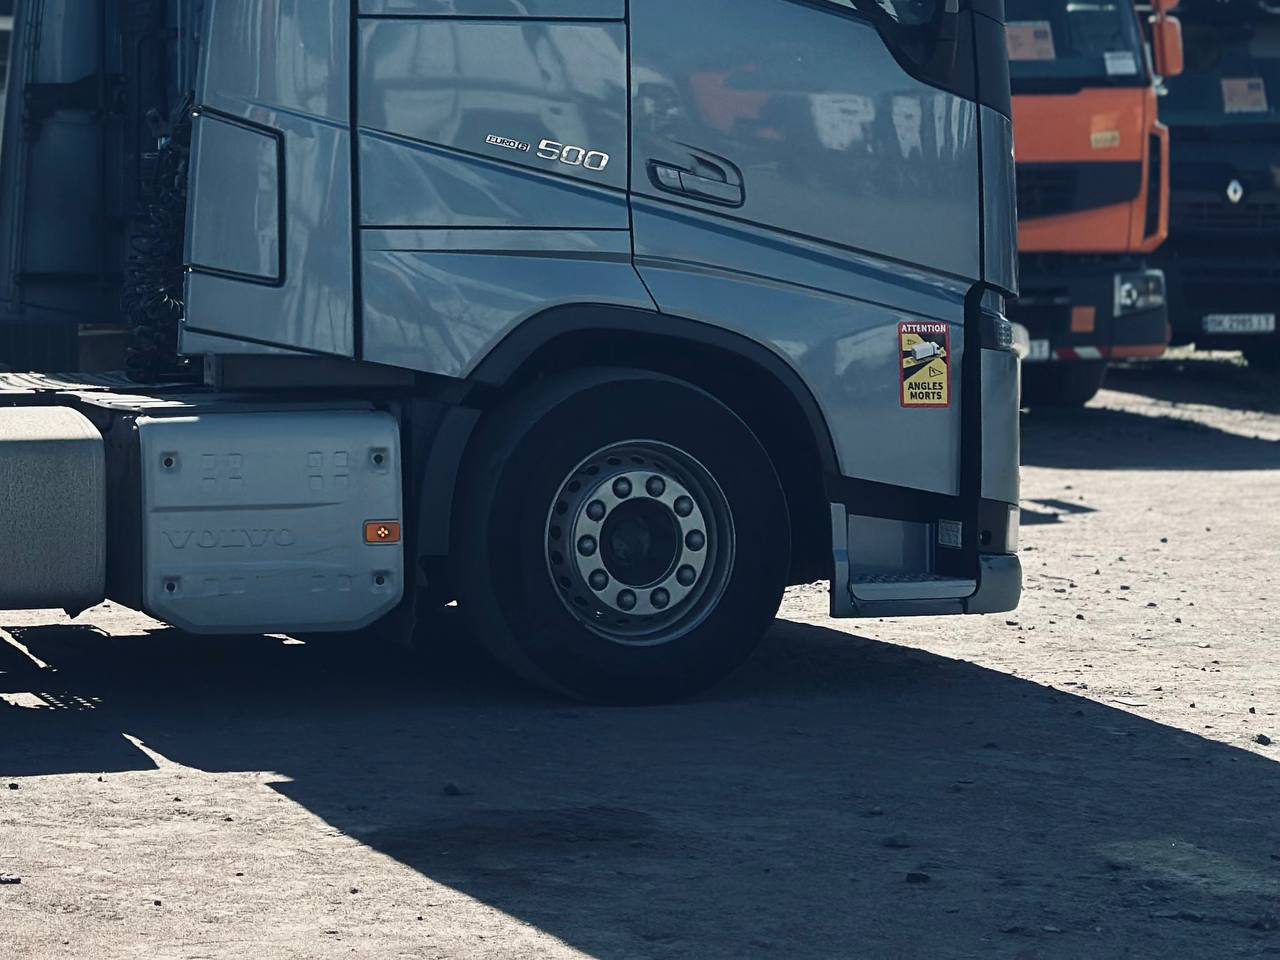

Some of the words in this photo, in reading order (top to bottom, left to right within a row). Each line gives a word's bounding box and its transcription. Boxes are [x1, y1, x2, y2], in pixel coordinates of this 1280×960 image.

[536, 139, 609, 171] 500
[902, 324, 946, 333] ATTENTION
[908, 382, 943, 391] ANGLES
[910, 392, 942, 400] MORTS
[161, 528, 296, 549] VOLVO
